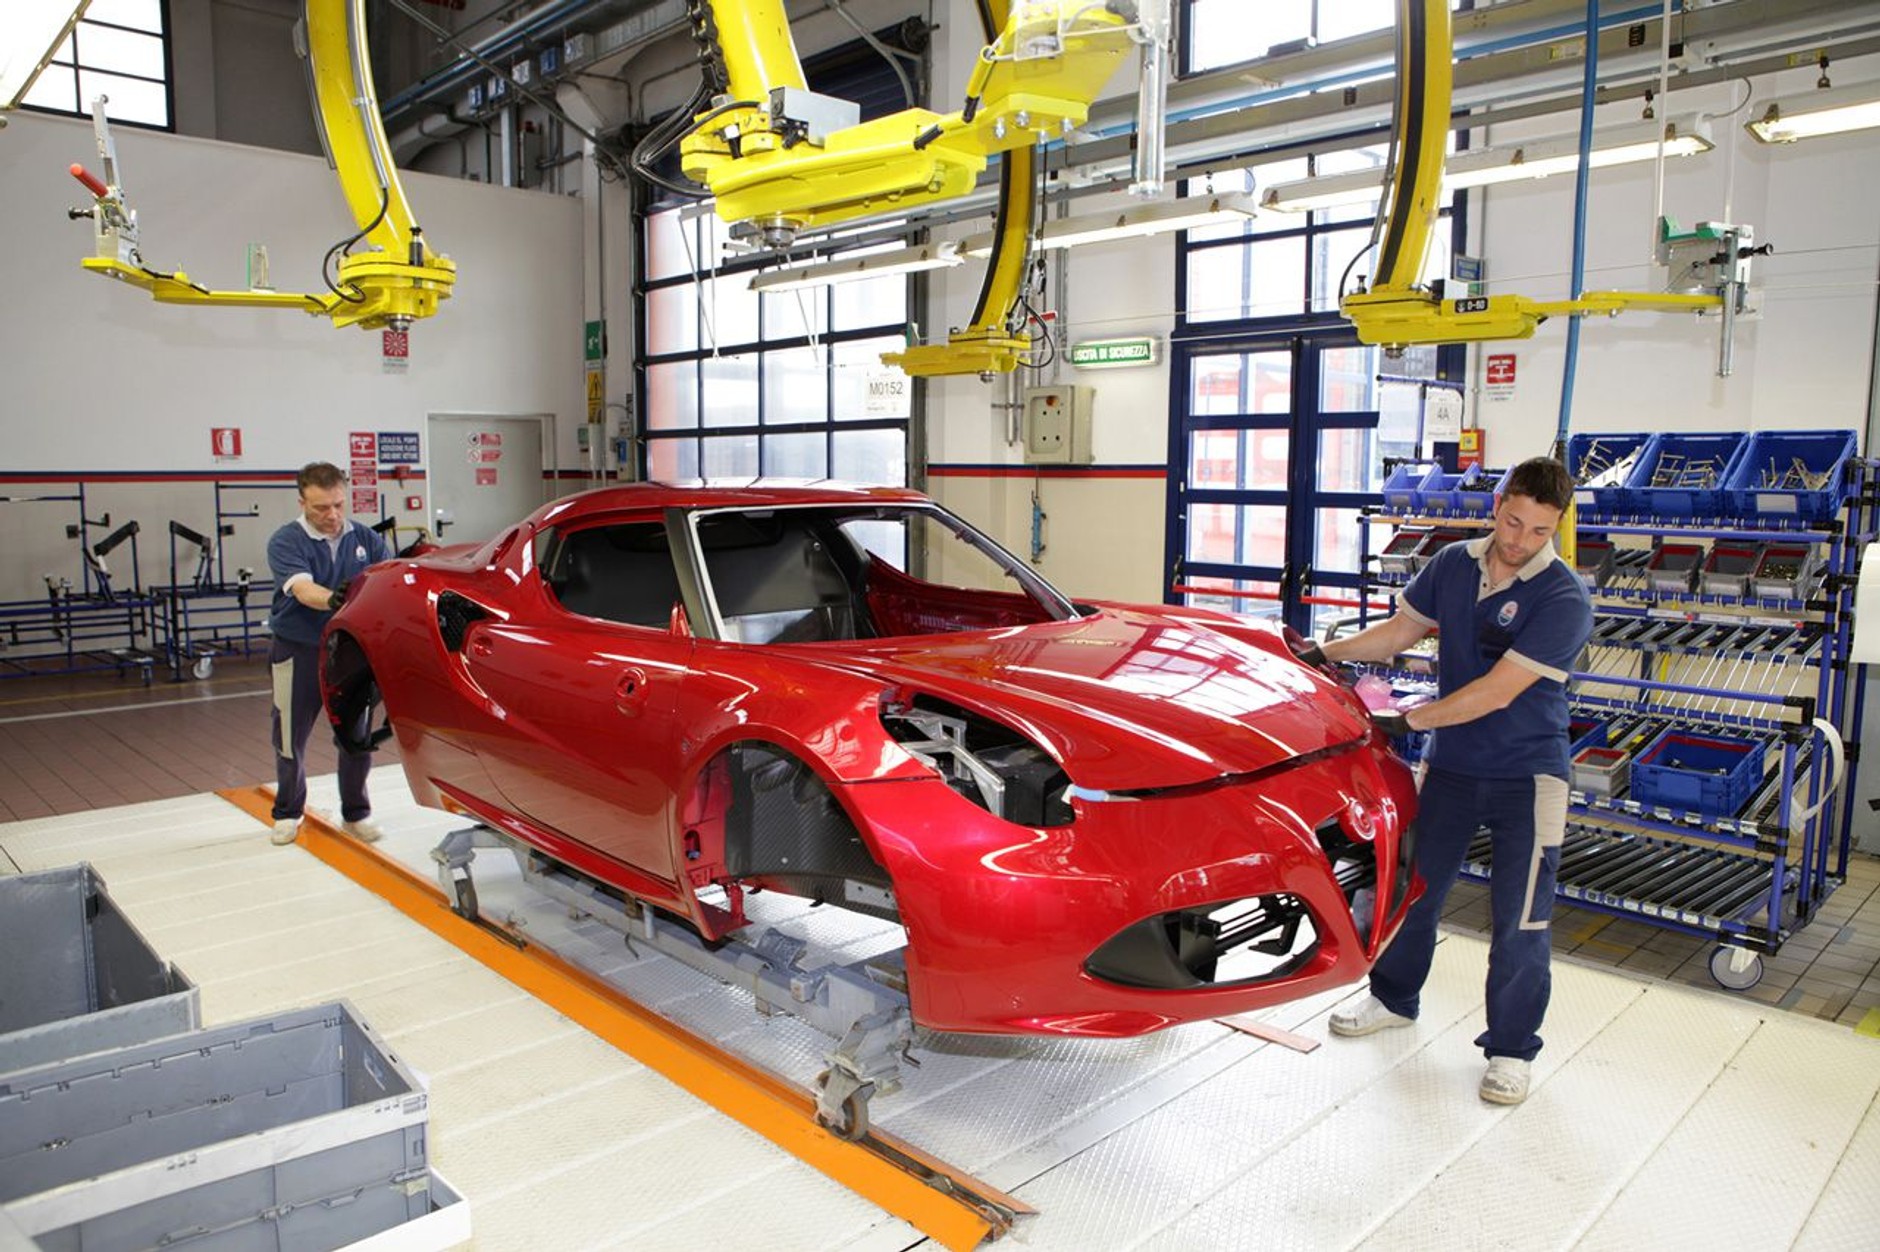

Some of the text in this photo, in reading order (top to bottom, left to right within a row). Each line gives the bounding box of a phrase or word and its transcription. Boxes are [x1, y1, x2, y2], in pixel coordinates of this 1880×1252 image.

[1073, 344, 1149, 361] USCITA DI SICUREZZA
[869, 381, 903, 396] M0152
